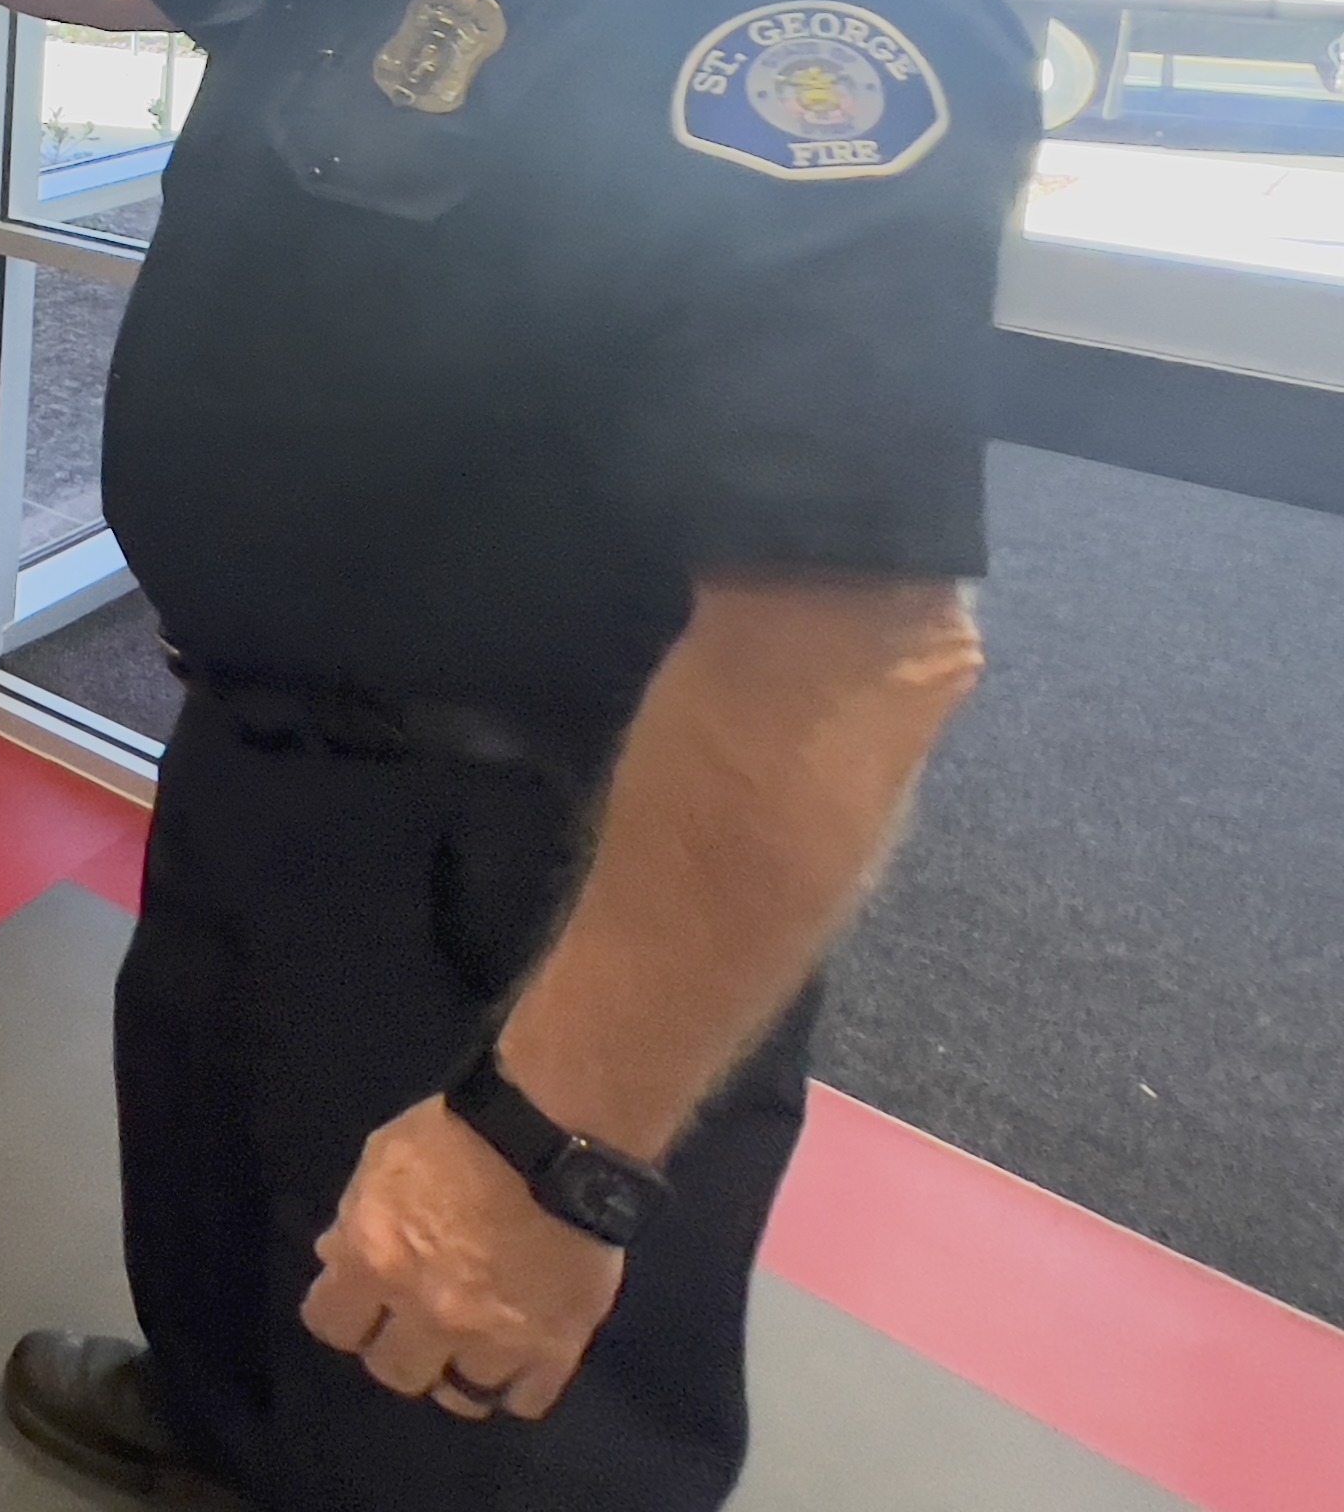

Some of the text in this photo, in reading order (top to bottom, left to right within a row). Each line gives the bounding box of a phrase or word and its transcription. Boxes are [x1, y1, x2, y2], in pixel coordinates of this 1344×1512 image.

[692, 48, 749, 94] ST.
[748, 12, 919, 80] GEORGE
[787, 140, 881, 167] FIRE
